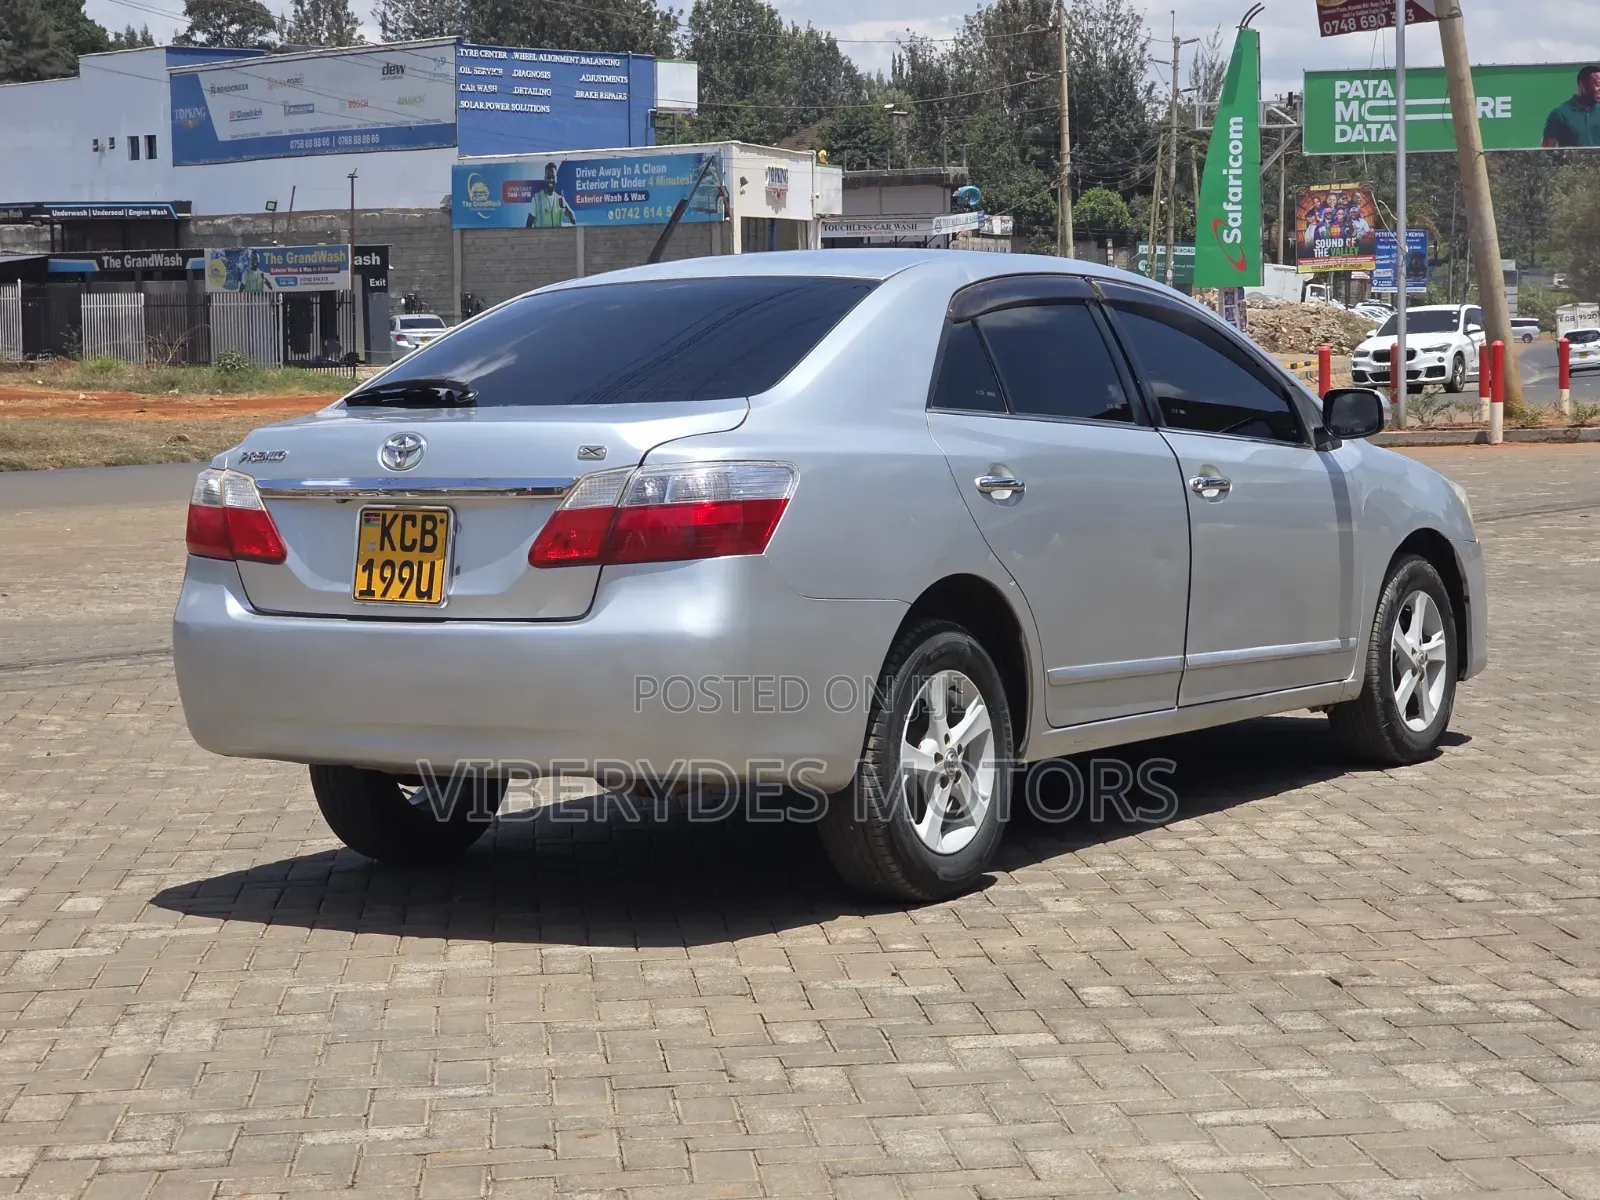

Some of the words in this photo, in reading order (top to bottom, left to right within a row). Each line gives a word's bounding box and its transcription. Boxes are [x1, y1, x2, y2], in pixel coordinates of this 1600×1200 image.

[1324, 18, 1356, 34] 0748
[1360, 13, 1386, 28] 690
[1390, 8, 1415, 24] 33
[480, 50, 507, 59] CENTER
[539, 54, 580, 64] ALIGNMENT
[382, 62, 406, 76] dew
[474, 66, 504, 76] SERVICE
[476, 84, 498, 92] WASH
[1335, 80, 1394, 99] PATA
[600, 92, 628, 100] REPAIRS
[348, 100, 369, 108] BOSCH
[486, 102, 510, 111] POWER
[511, 103, 550, 113] SOLUTIONS
[173, 106, 206, 120] TOPKING
[338, 136, 352, 145] 0768
[1335, 124, 1397, 143] DATA
[576, 167, 597, 178] Drive
[599, 166, 621, 178] Away
[624, 165, 632, 175] In
[634, 164, 640, 174] A
[642, 164, 667, 174] Clean
[576, 180, 608, 190] Exterior
[610, 179, 619, 189] In
[621, 178, 646, 188] Under
[648, 176, 654, 186] 4
[656, 174, 693, 186] Minutes!
[1222, 117, 1243, 244] Safaricom
[576, 195, 603, 203] Exterior
[604, 193, 622, 202] Wash
[624, 193, 629, 201] &
[631, 193, 646, 201] Wax
[615, 207, 640, 220] 0742
[644, 206, 662, 218] 614
[1316, 239, 1344, 249] SOUND
[1346, 238, 1356, 247] OF
[263, 252, 282, 265] The
[286, 250, 346, 264] GrandWash
[1313, 247, 1329, 257] THE
[1330, 246, 1359, 256] VALLEY
[102, 256, 121, 268] The
[124, 254, 182, 268] GrandWash
[370, 278, 386, 286] Exit
[380, 513, 438, 553] KCB
[358, 558, 436, 600] 199U
